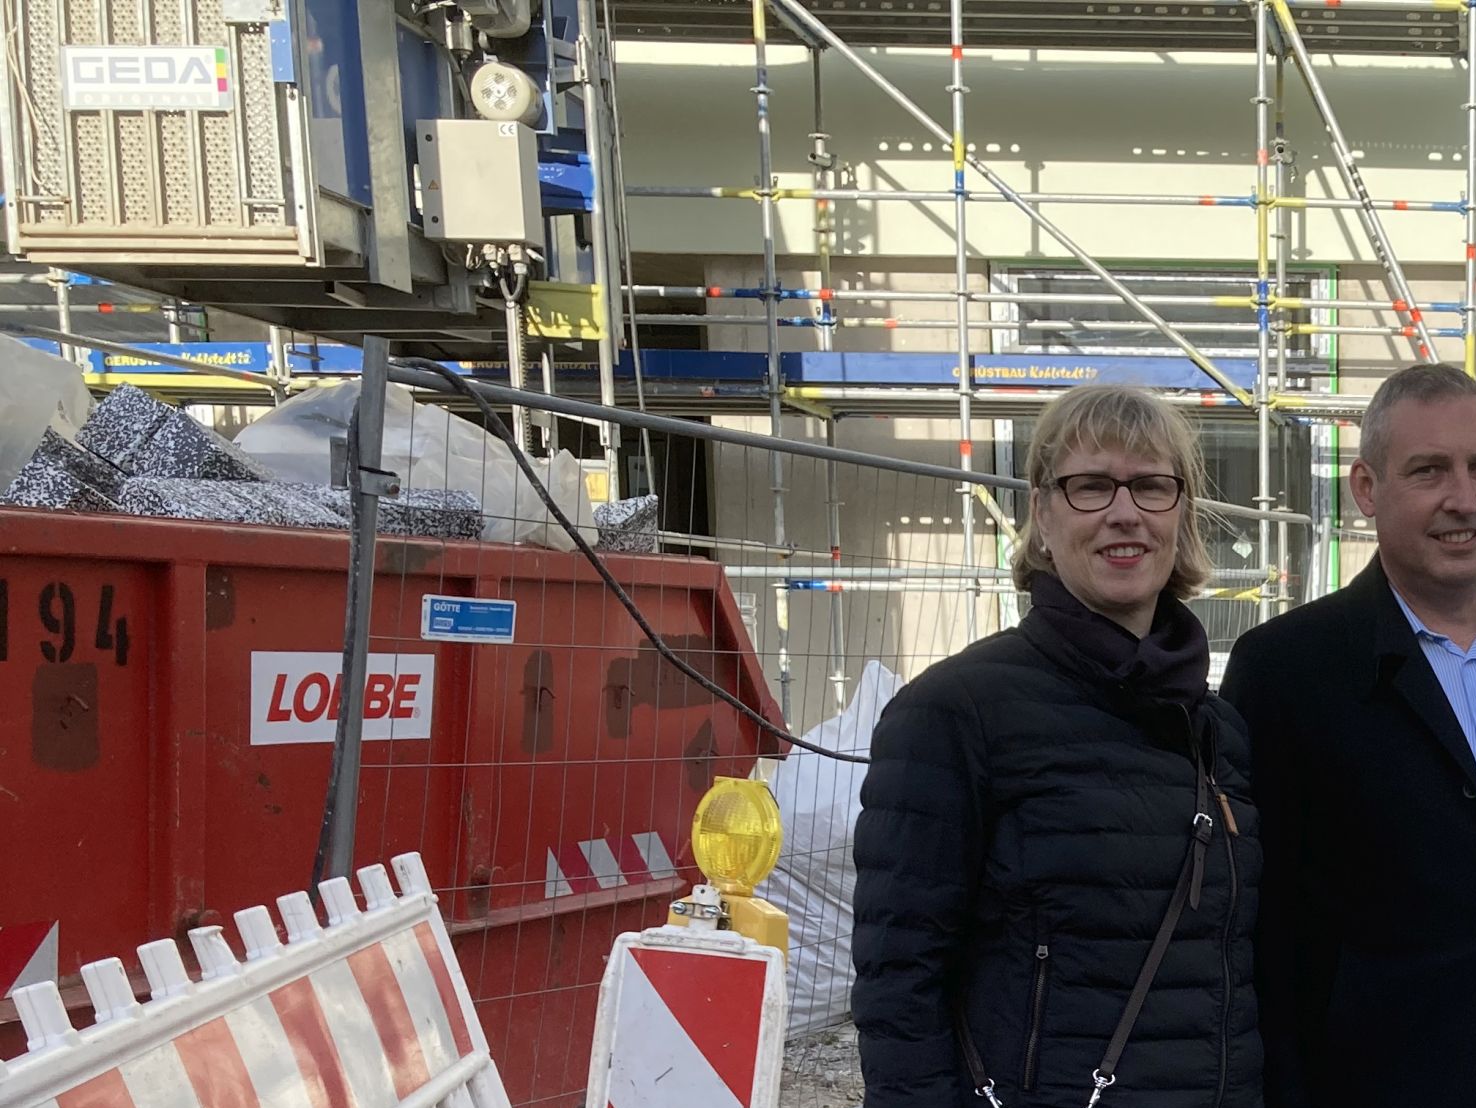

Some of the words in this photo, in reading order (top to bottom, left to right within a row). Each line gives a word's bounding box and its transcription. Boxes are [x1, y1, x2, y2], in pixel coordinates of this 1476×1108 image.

[72, 57, 211, 84] GEDA
[952, 365, 1026, 379] GRÜSTBAU
[433, 601, 461, 613] GÖTTE
